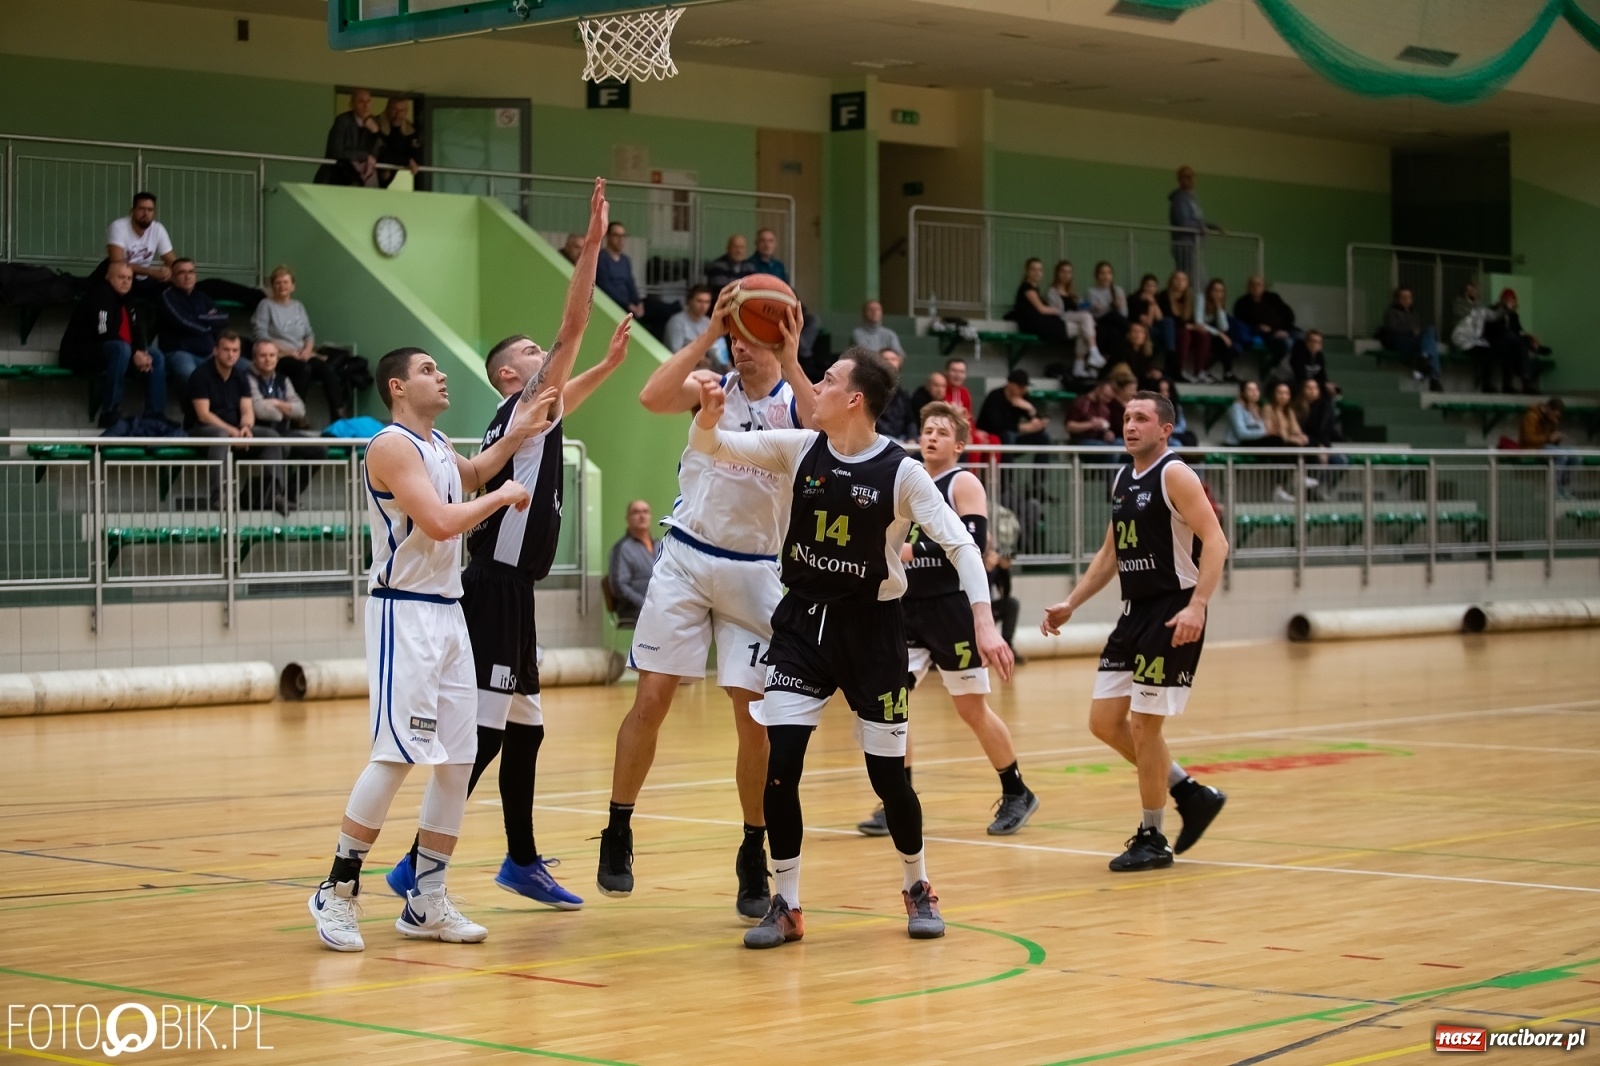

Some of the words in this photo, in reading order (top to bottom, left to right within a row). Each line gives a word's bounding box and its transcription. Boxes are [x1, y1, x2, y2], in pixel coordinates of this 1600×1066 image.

[600, 88, 619, 106] F
[841, 106, 858, 127] F
[852, 486, 878, 502] STELA
[814, 509, 851, 547] 14
[1116, 519, 1138, 550] 24
[794, 542, 867, 579] Nacomi
[954, 641, 972, 669] 5
[1132, 654, 1166, 684] 24
[878, 687, 908, 721] 14
